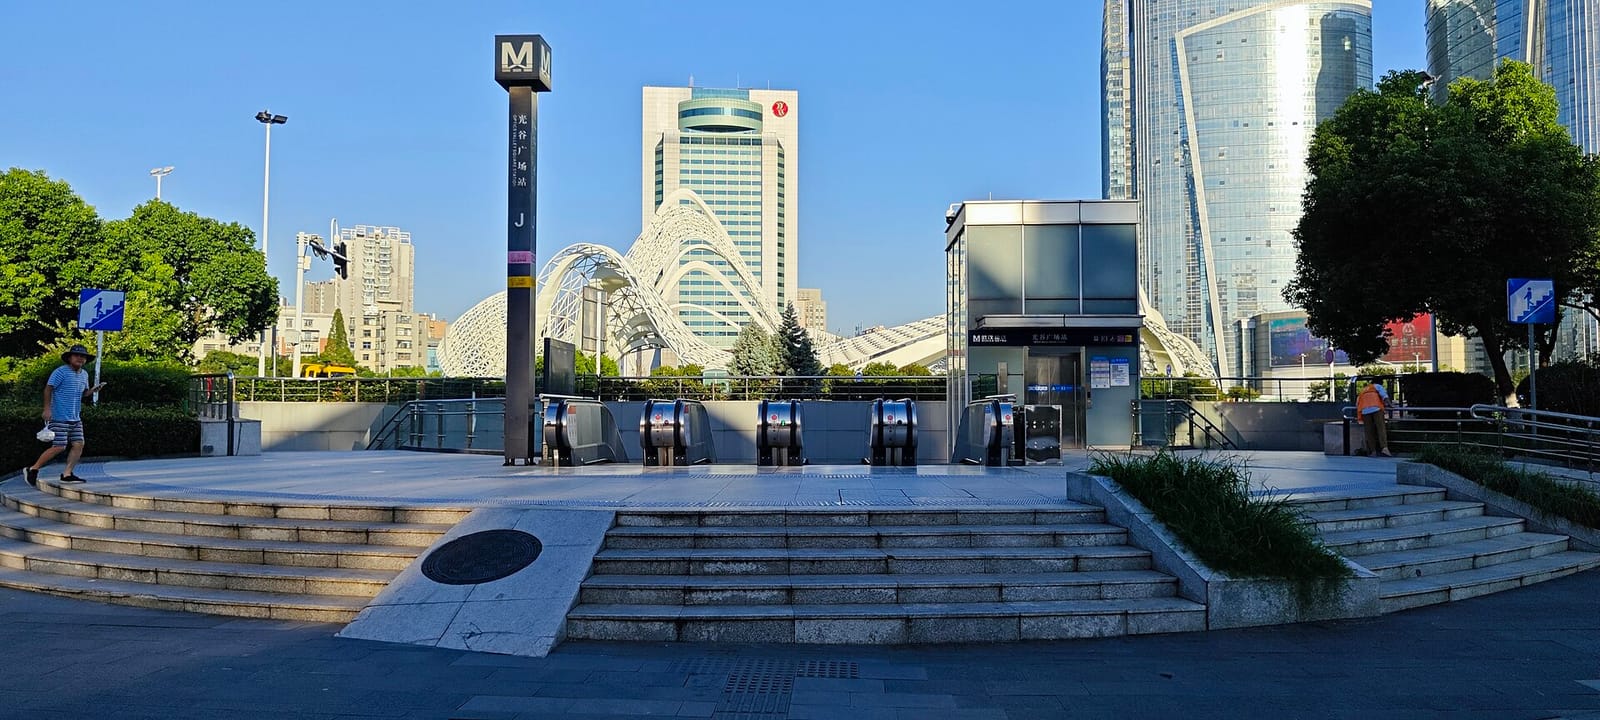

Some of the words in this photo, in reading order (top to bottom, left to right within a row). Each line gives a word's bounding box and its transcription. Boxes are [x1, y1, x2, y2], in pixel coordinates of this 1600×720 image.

[501, 41, 533, 72] M
[518, 114, 528, 187] 光谷广场站
[514, 212, 525, 228] J
